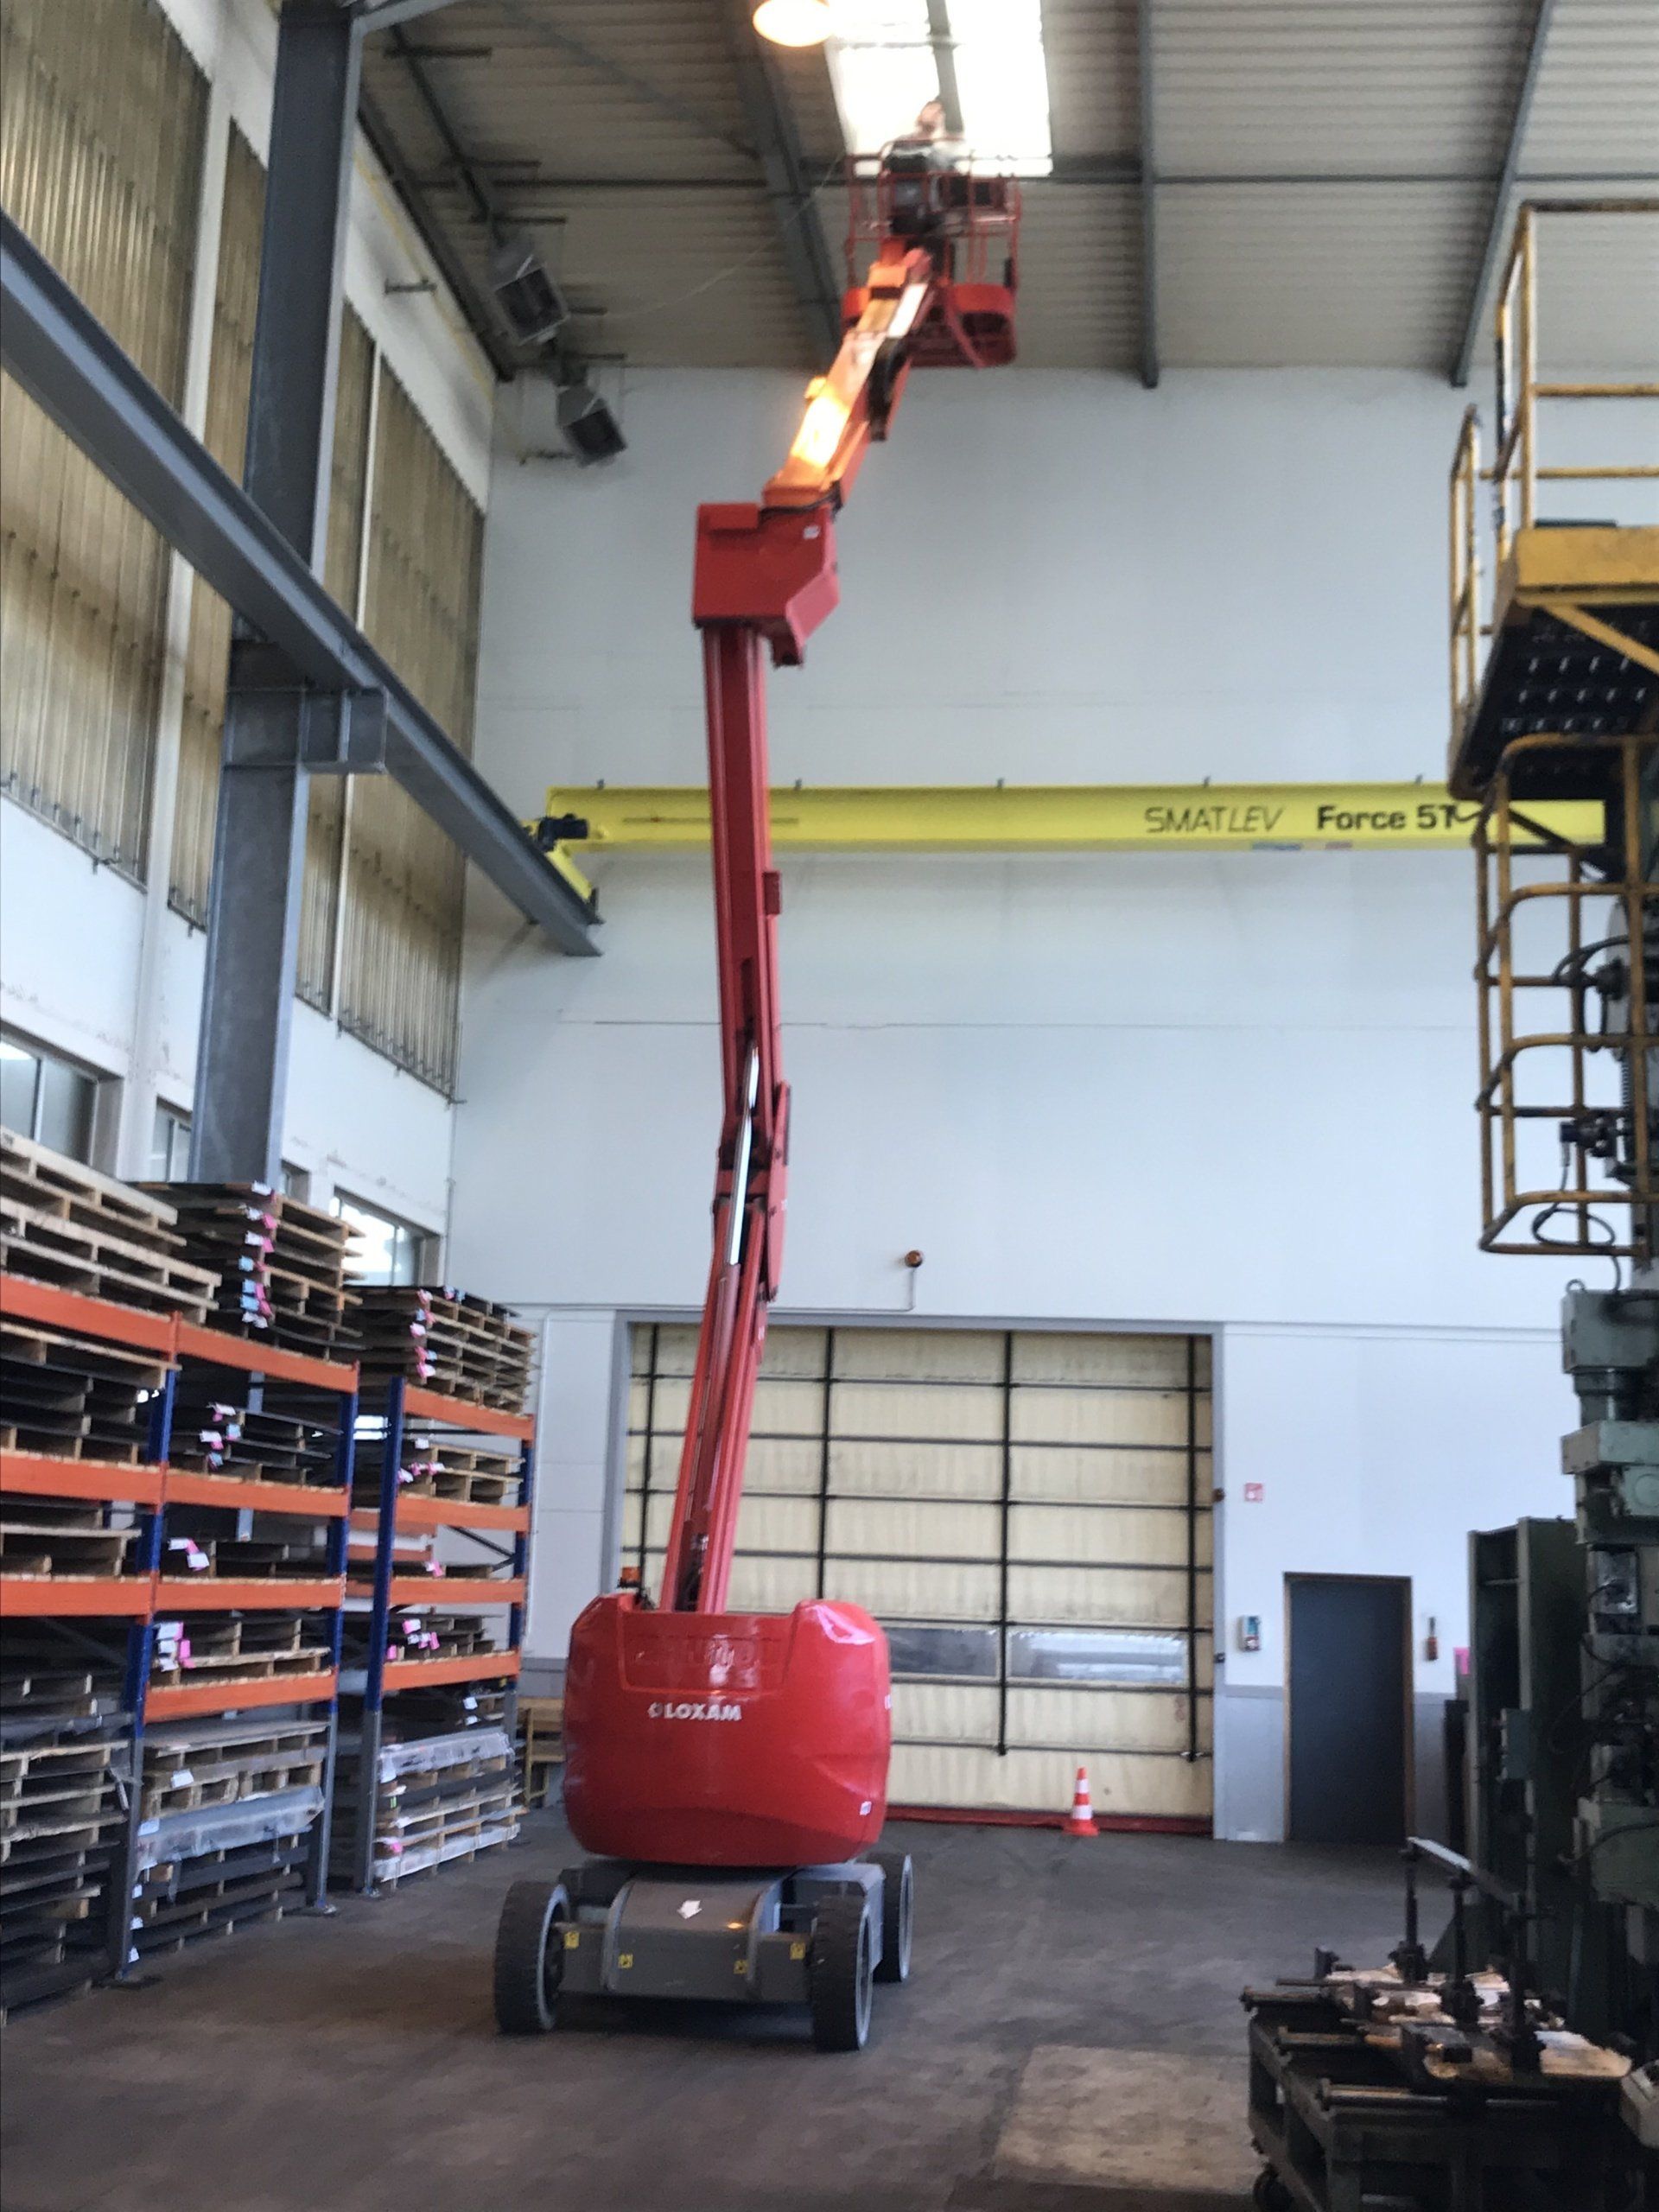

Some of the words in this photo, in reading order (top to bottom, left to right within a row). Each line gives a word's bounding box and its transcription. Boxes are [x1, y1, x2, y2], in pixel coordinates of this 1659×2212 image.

[1144, 805, 1286, 834] SMATLEV
[1317, 804, 1407, 830] Force
[664, 1702, 742, 1721] LOXAM
